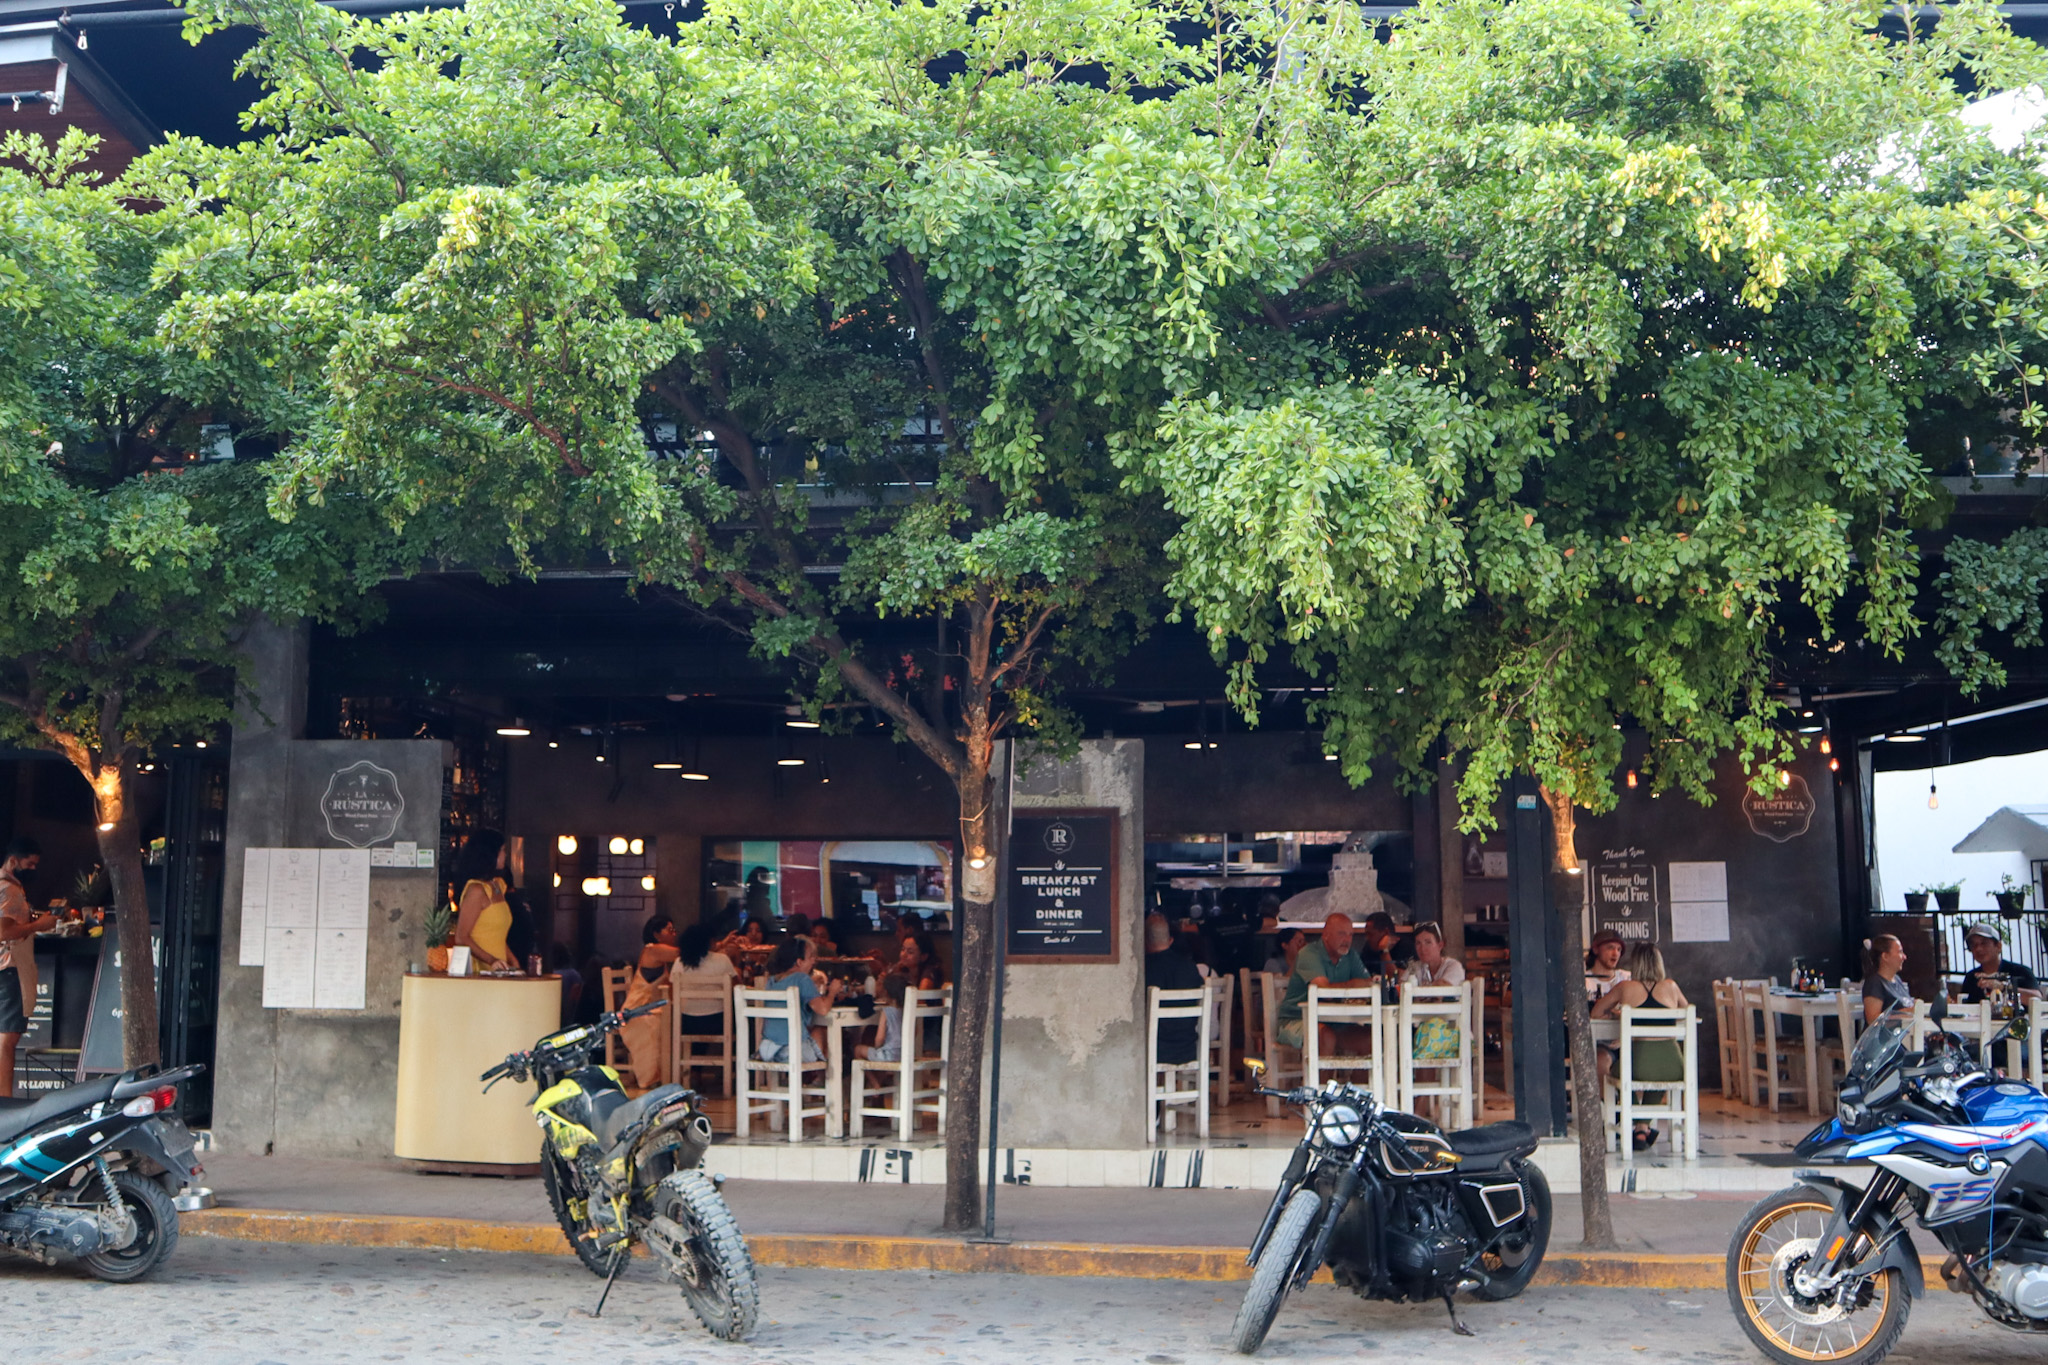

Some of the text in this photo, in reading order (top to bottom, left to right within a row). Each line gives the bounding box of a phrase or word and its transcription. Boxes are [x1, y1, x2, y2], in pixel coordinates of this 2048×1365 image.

[354, 791, 368, 799] LA
[1050, 828, 1067, 844] R
[1602, 846, 1645, 860] Thank You
[1021, 875, 1097, 885] BREAKFAST
[1601, 872, 1648, 888] Keeping Our
[1037, 887, 1081, 897] LUNCH
[1602, 886, 1650, 902] Wood Fire
[1054, 898, 1065, 908] &
[1035, 909, 1083, 919] DINNER
